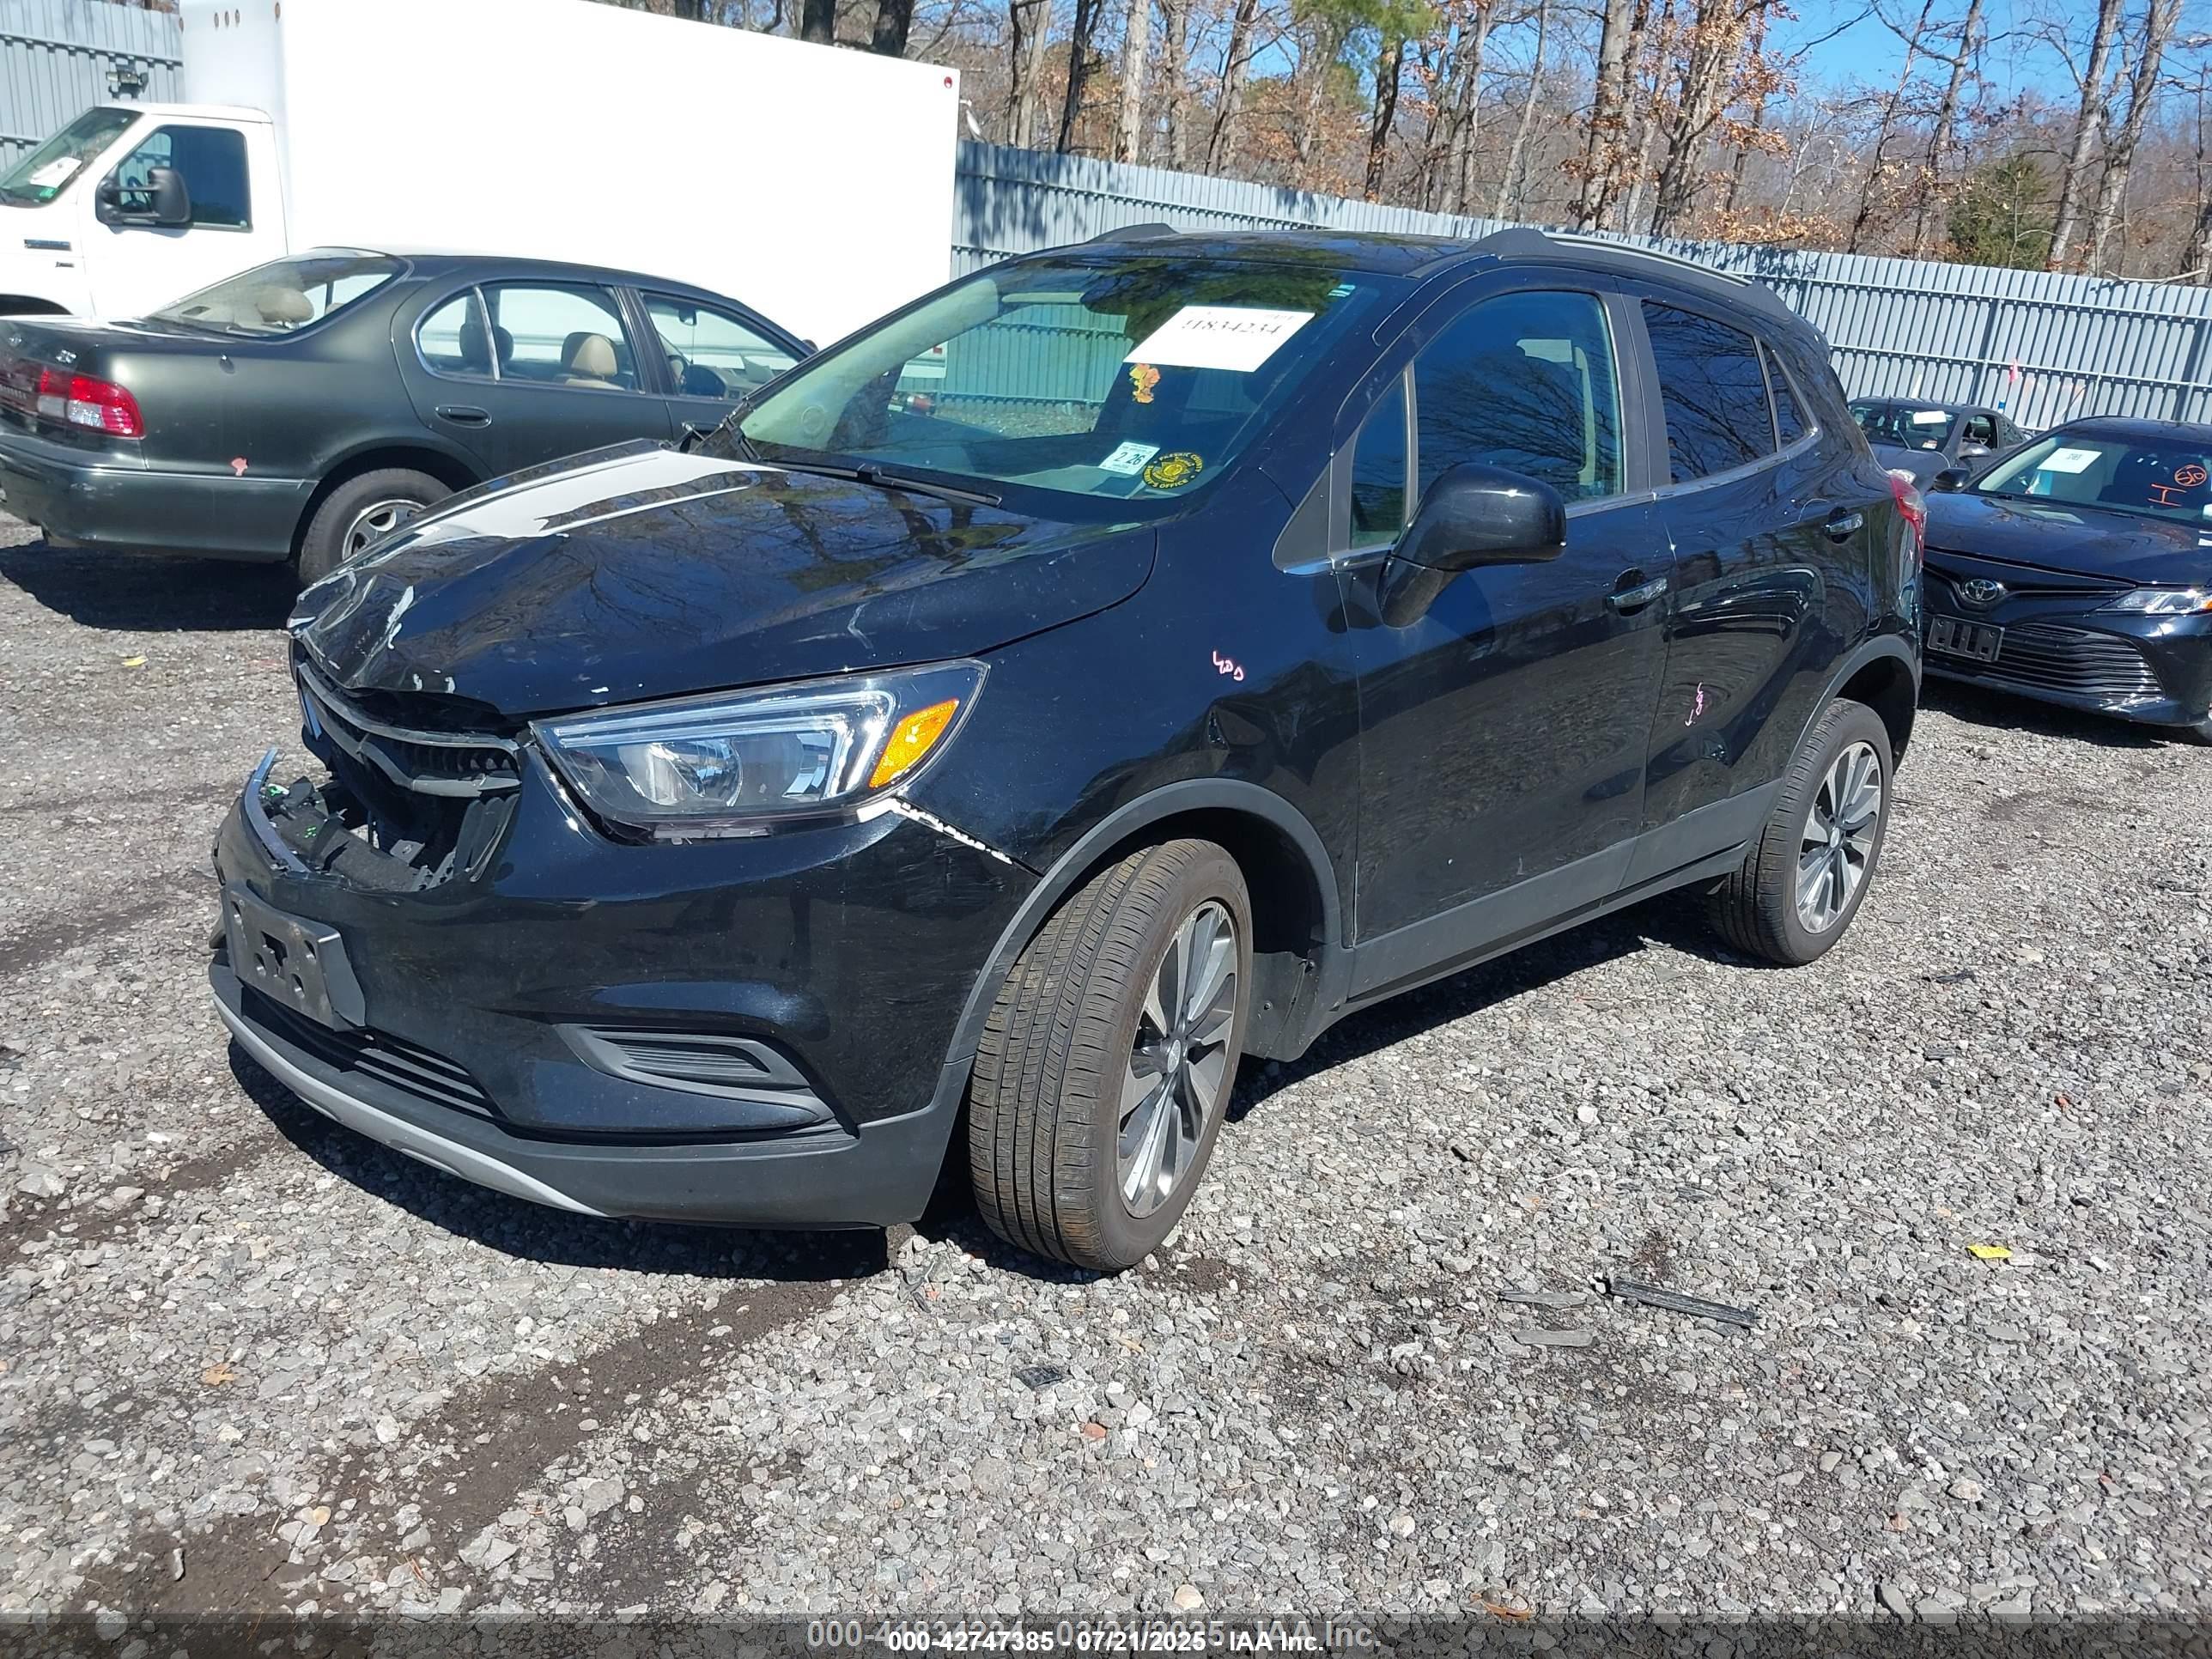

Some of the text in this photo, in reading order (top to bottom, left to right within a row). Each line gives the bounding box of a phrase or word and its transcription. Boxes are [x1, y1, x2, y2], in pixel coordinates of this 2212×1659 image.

[1126, 453, 1146, 465] 26
[1190, 454, 1203, 472] COUNTY
[1159, 478, 1189, 489] OFFICE
